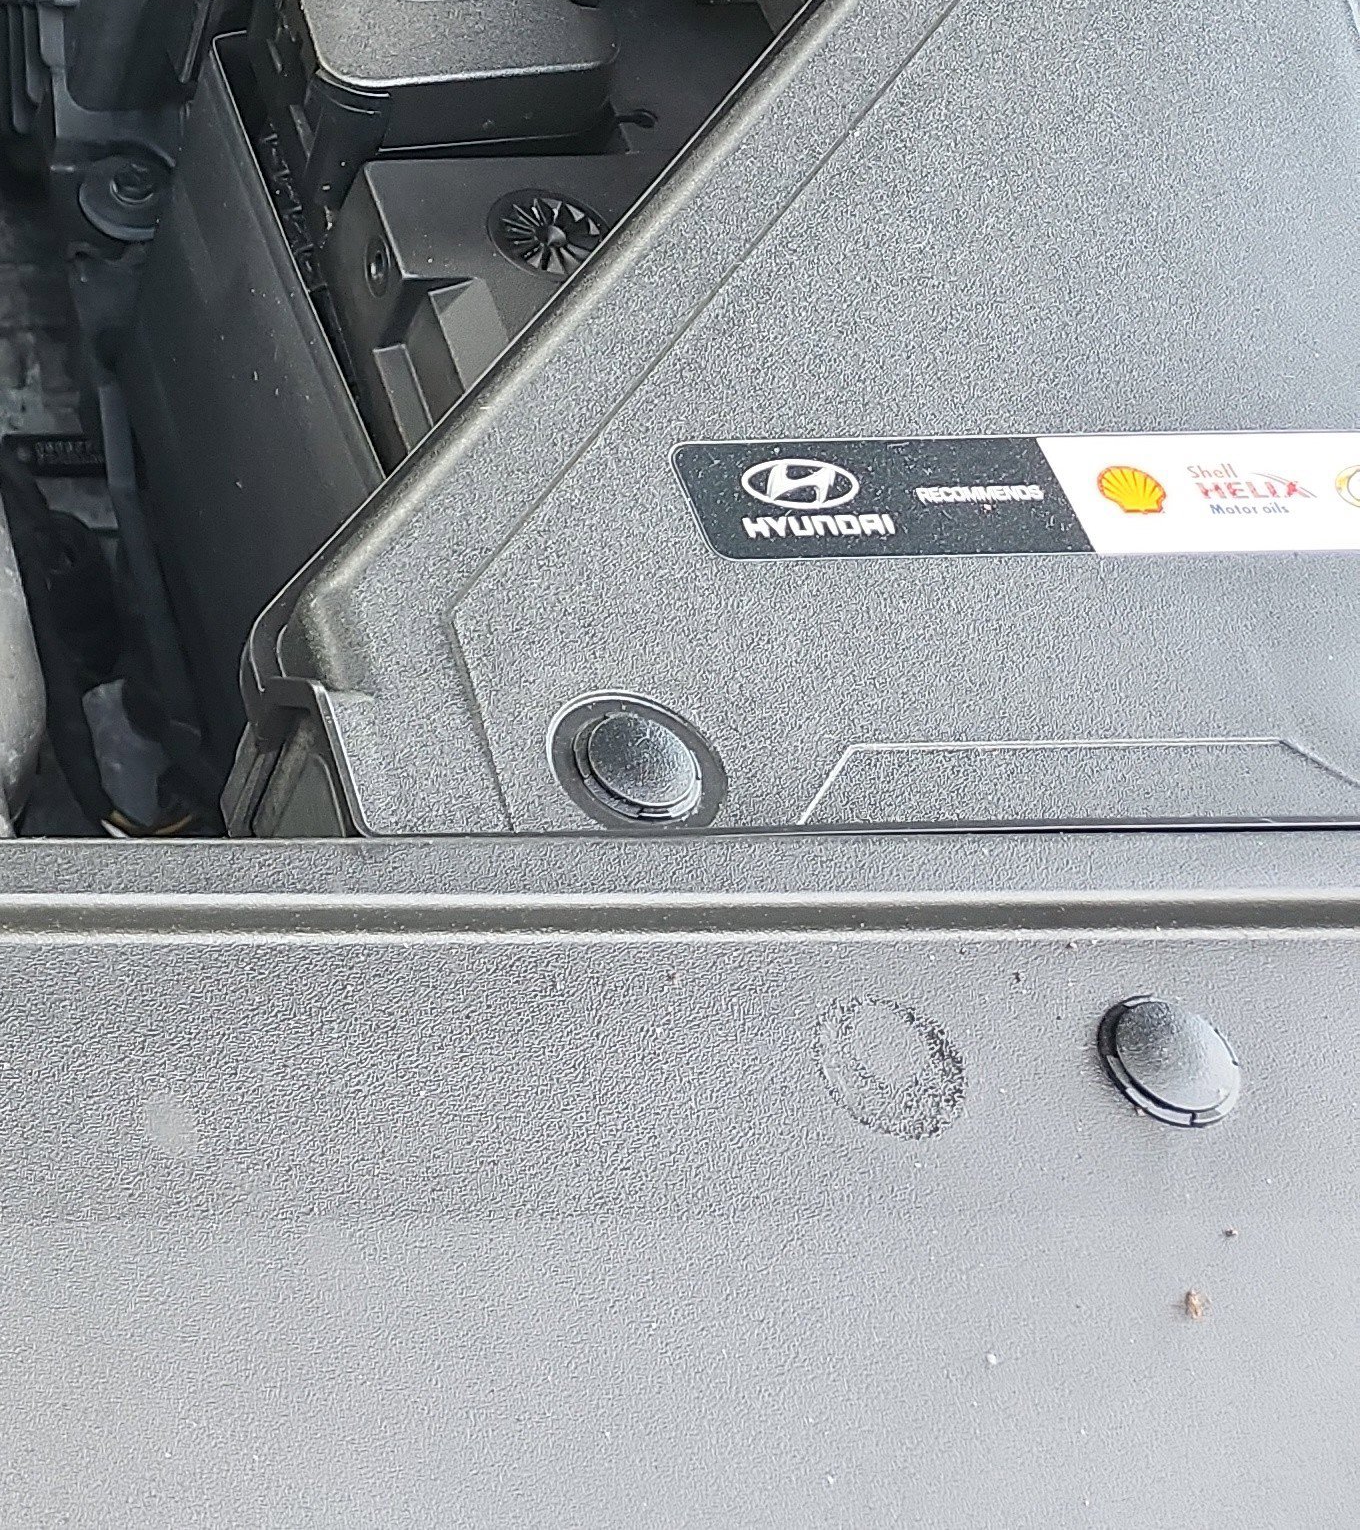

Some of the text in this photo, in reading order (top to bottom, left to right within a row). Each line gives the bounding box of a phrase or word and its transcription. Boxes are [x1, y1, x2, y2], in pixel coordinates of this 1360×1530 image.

[1186, 463, 1239, 479] Shell
[1194, 480, 1312, 499] HELIX
[742, 483, 1045, 539] HYUNDAI RECOMMENDS
[1209, 501, 1290, 515] Motor oils
